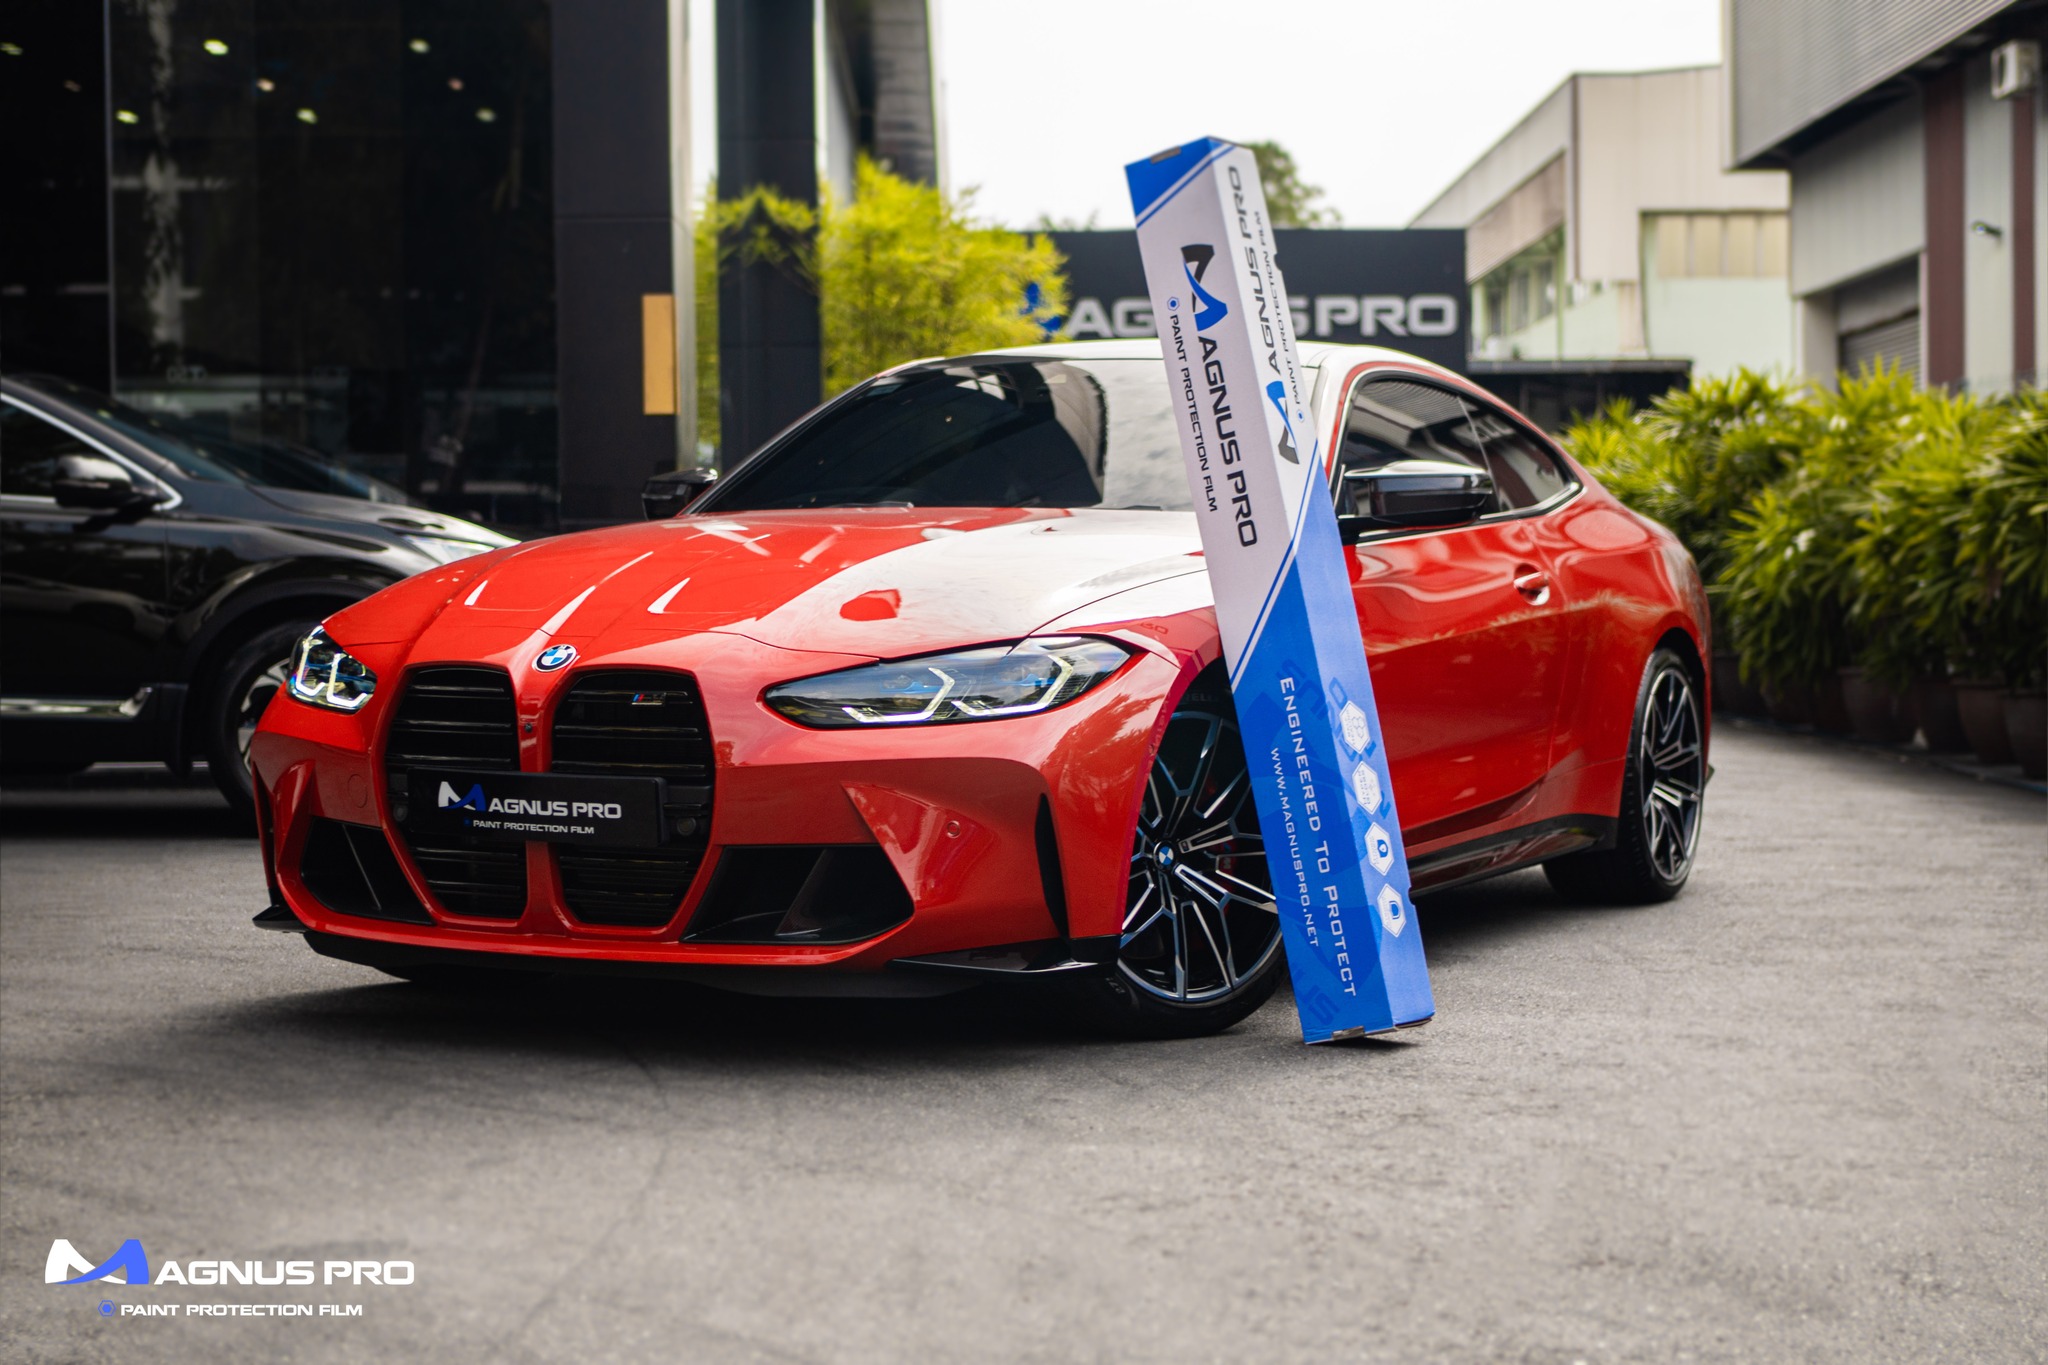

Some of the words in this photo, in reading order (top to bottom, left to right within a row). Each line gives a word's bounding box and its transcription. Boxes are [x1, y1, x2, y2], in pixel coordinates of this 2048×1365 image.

[1228, 165, 1252, 240] PRO
[1263, 250, 1289, 352] PROTECTION
[1315, 294, 1459, 337] PRO
[1169, 314, 1188, 362] PAINT
[1180, 367, 1209, 471] PROTECTION
[1203, 475, 1218, 512] FILM
[1285, 357, 1301, 405] PAINT
[1226, 470, 1258, 547] PRO
[472, 819, 502, 830] PAINT
[503, 822, 568, 834] PROTECTION
[570, 825, 595, 835] FILM
[572, 802, 622, 819] PRO
[1270, 747, 1319, 948] WWW.MAGNUSPRO.NET
[1280, 676, 1322, 832] ENGINEERED
[1314, 840, 1331, 874] TO
[1323, 885, 1357, 997] PROTECT
